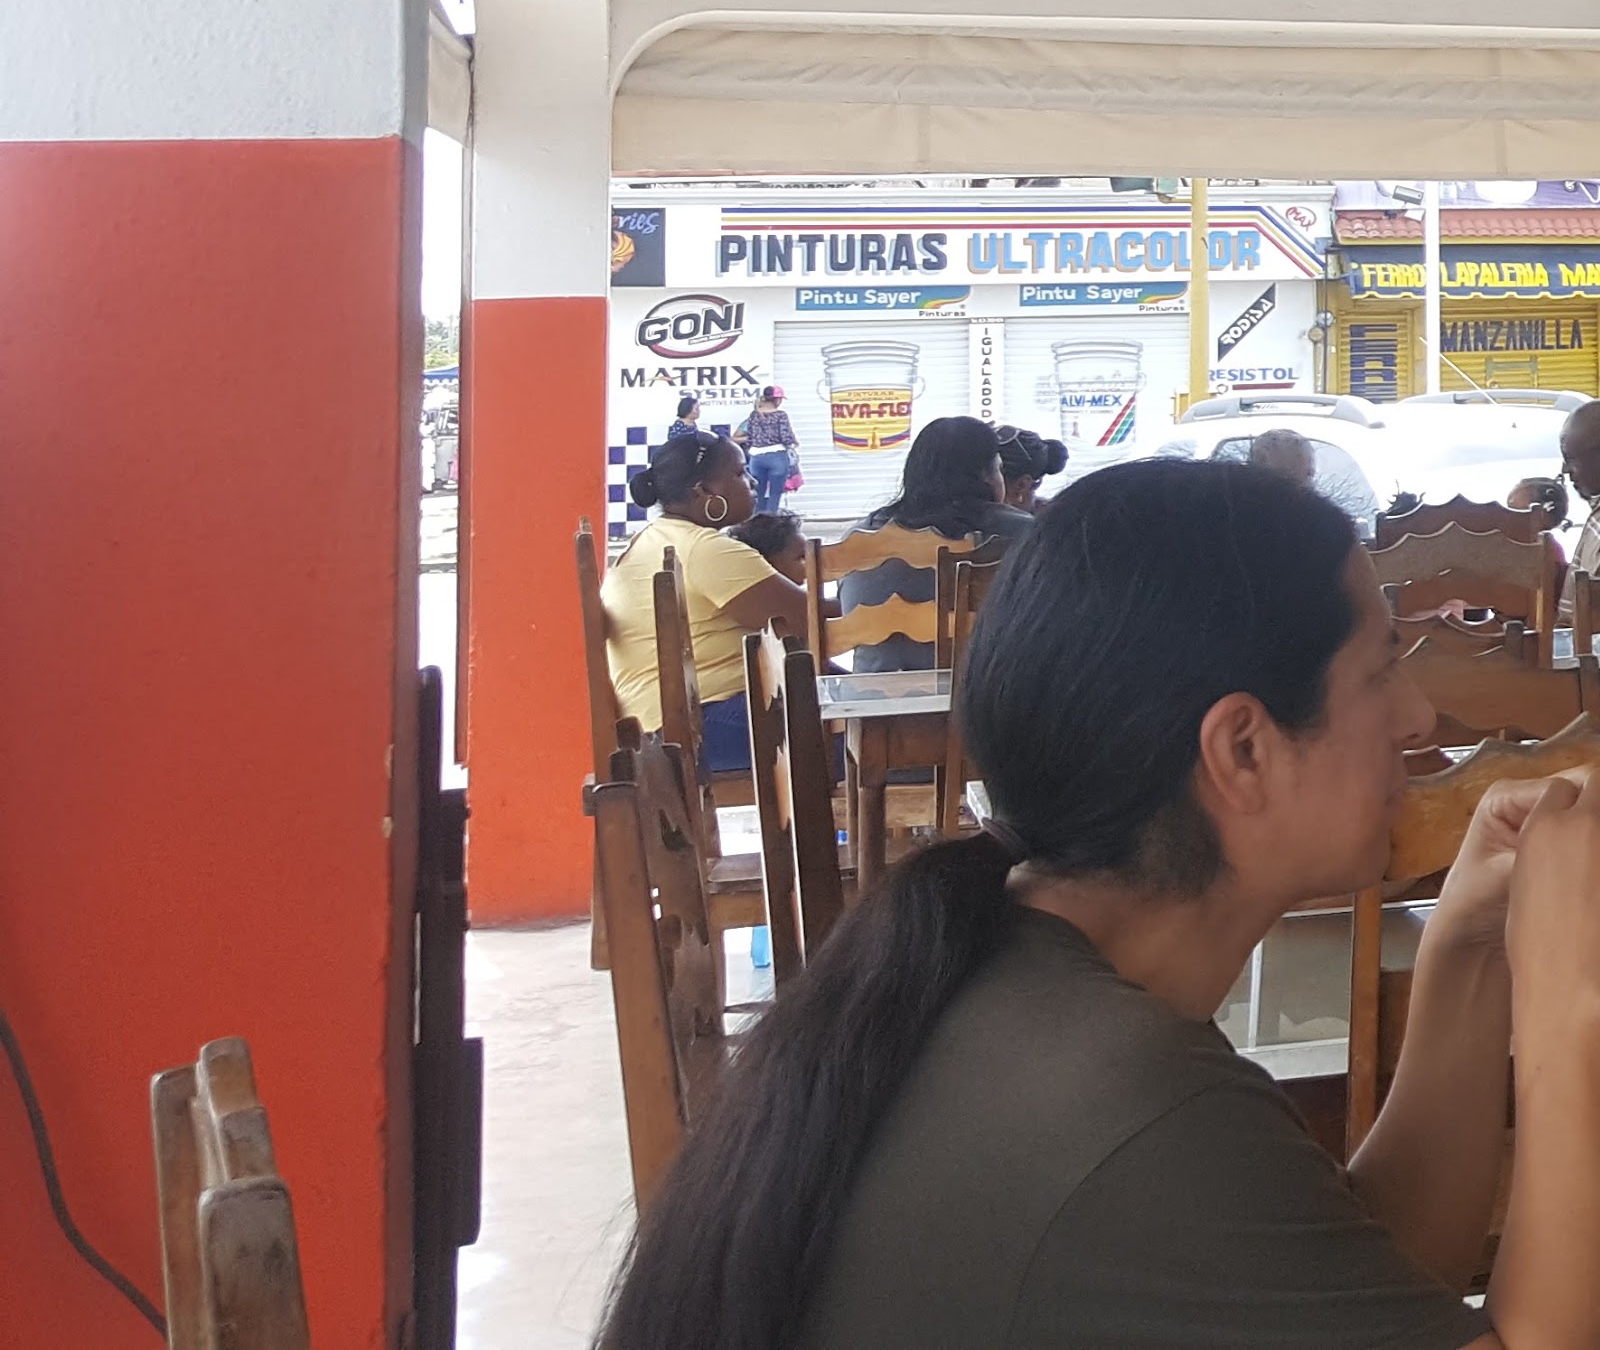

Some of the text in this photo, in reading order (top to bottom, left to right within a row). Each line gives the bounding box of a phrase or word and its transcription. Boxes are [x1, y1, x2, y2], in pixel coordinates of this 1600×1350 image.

[716, 230, 1261, 277] PINTURAS ULTRACOLOR
[800, 287, 922, 308] Pintu Sayer
[1022, 284, 1143, 303] Pintu Sayer
[636, 302, 745, 347] GONI
[620, 365, 760, 388] MATRIX
